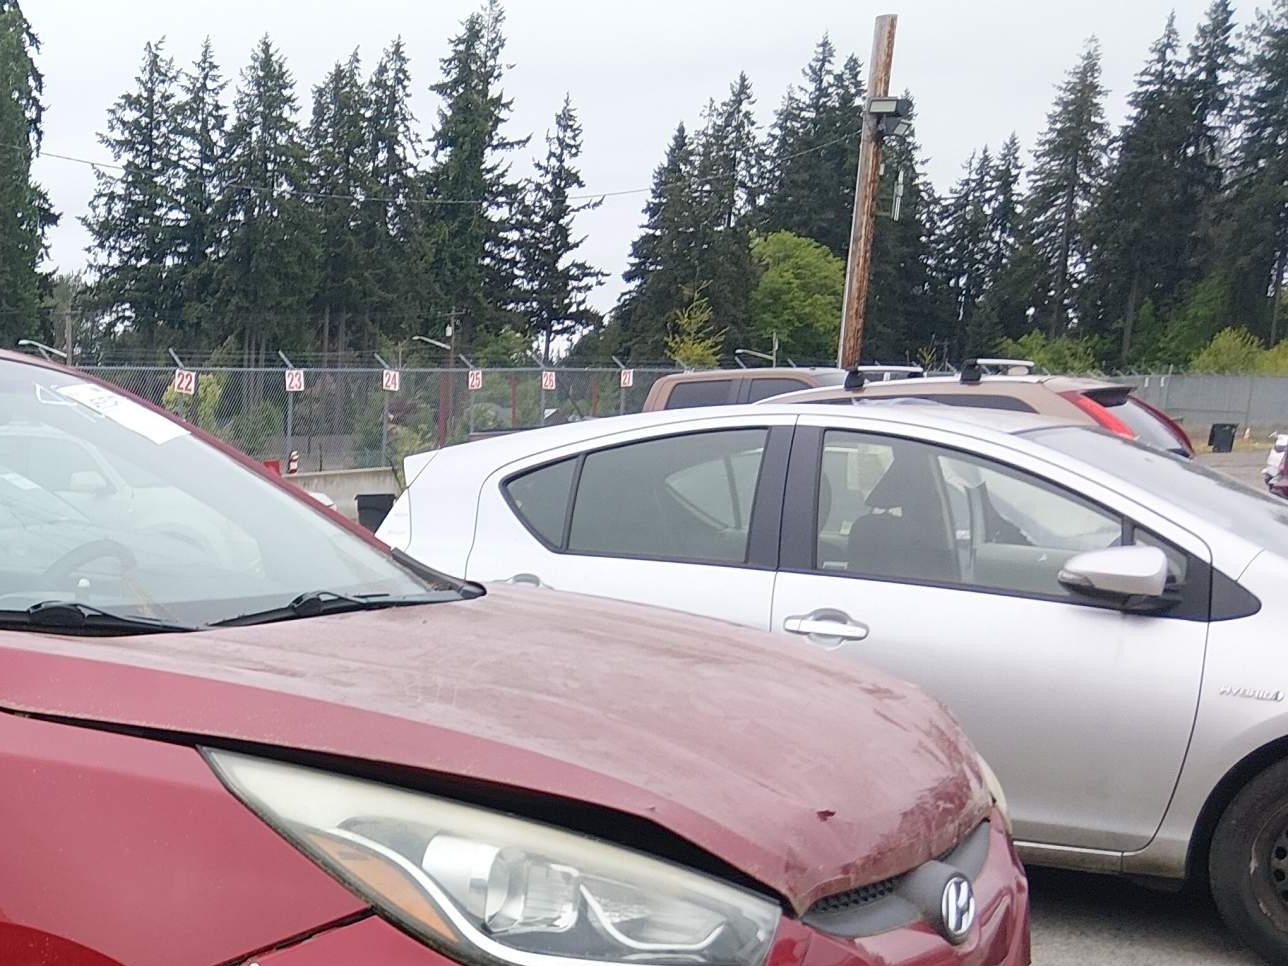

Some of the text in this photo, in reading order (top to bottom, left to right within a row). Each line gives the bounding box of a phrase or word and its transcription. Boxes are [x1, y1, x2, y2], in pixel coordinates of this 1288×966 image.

[177, 371, 193, 392] 22
[288, 371, 302, 390] 23
[384, 371, 398, 389] 24
[470, 372, 481, 388] 25
[622, 371, 632, 386] 27
